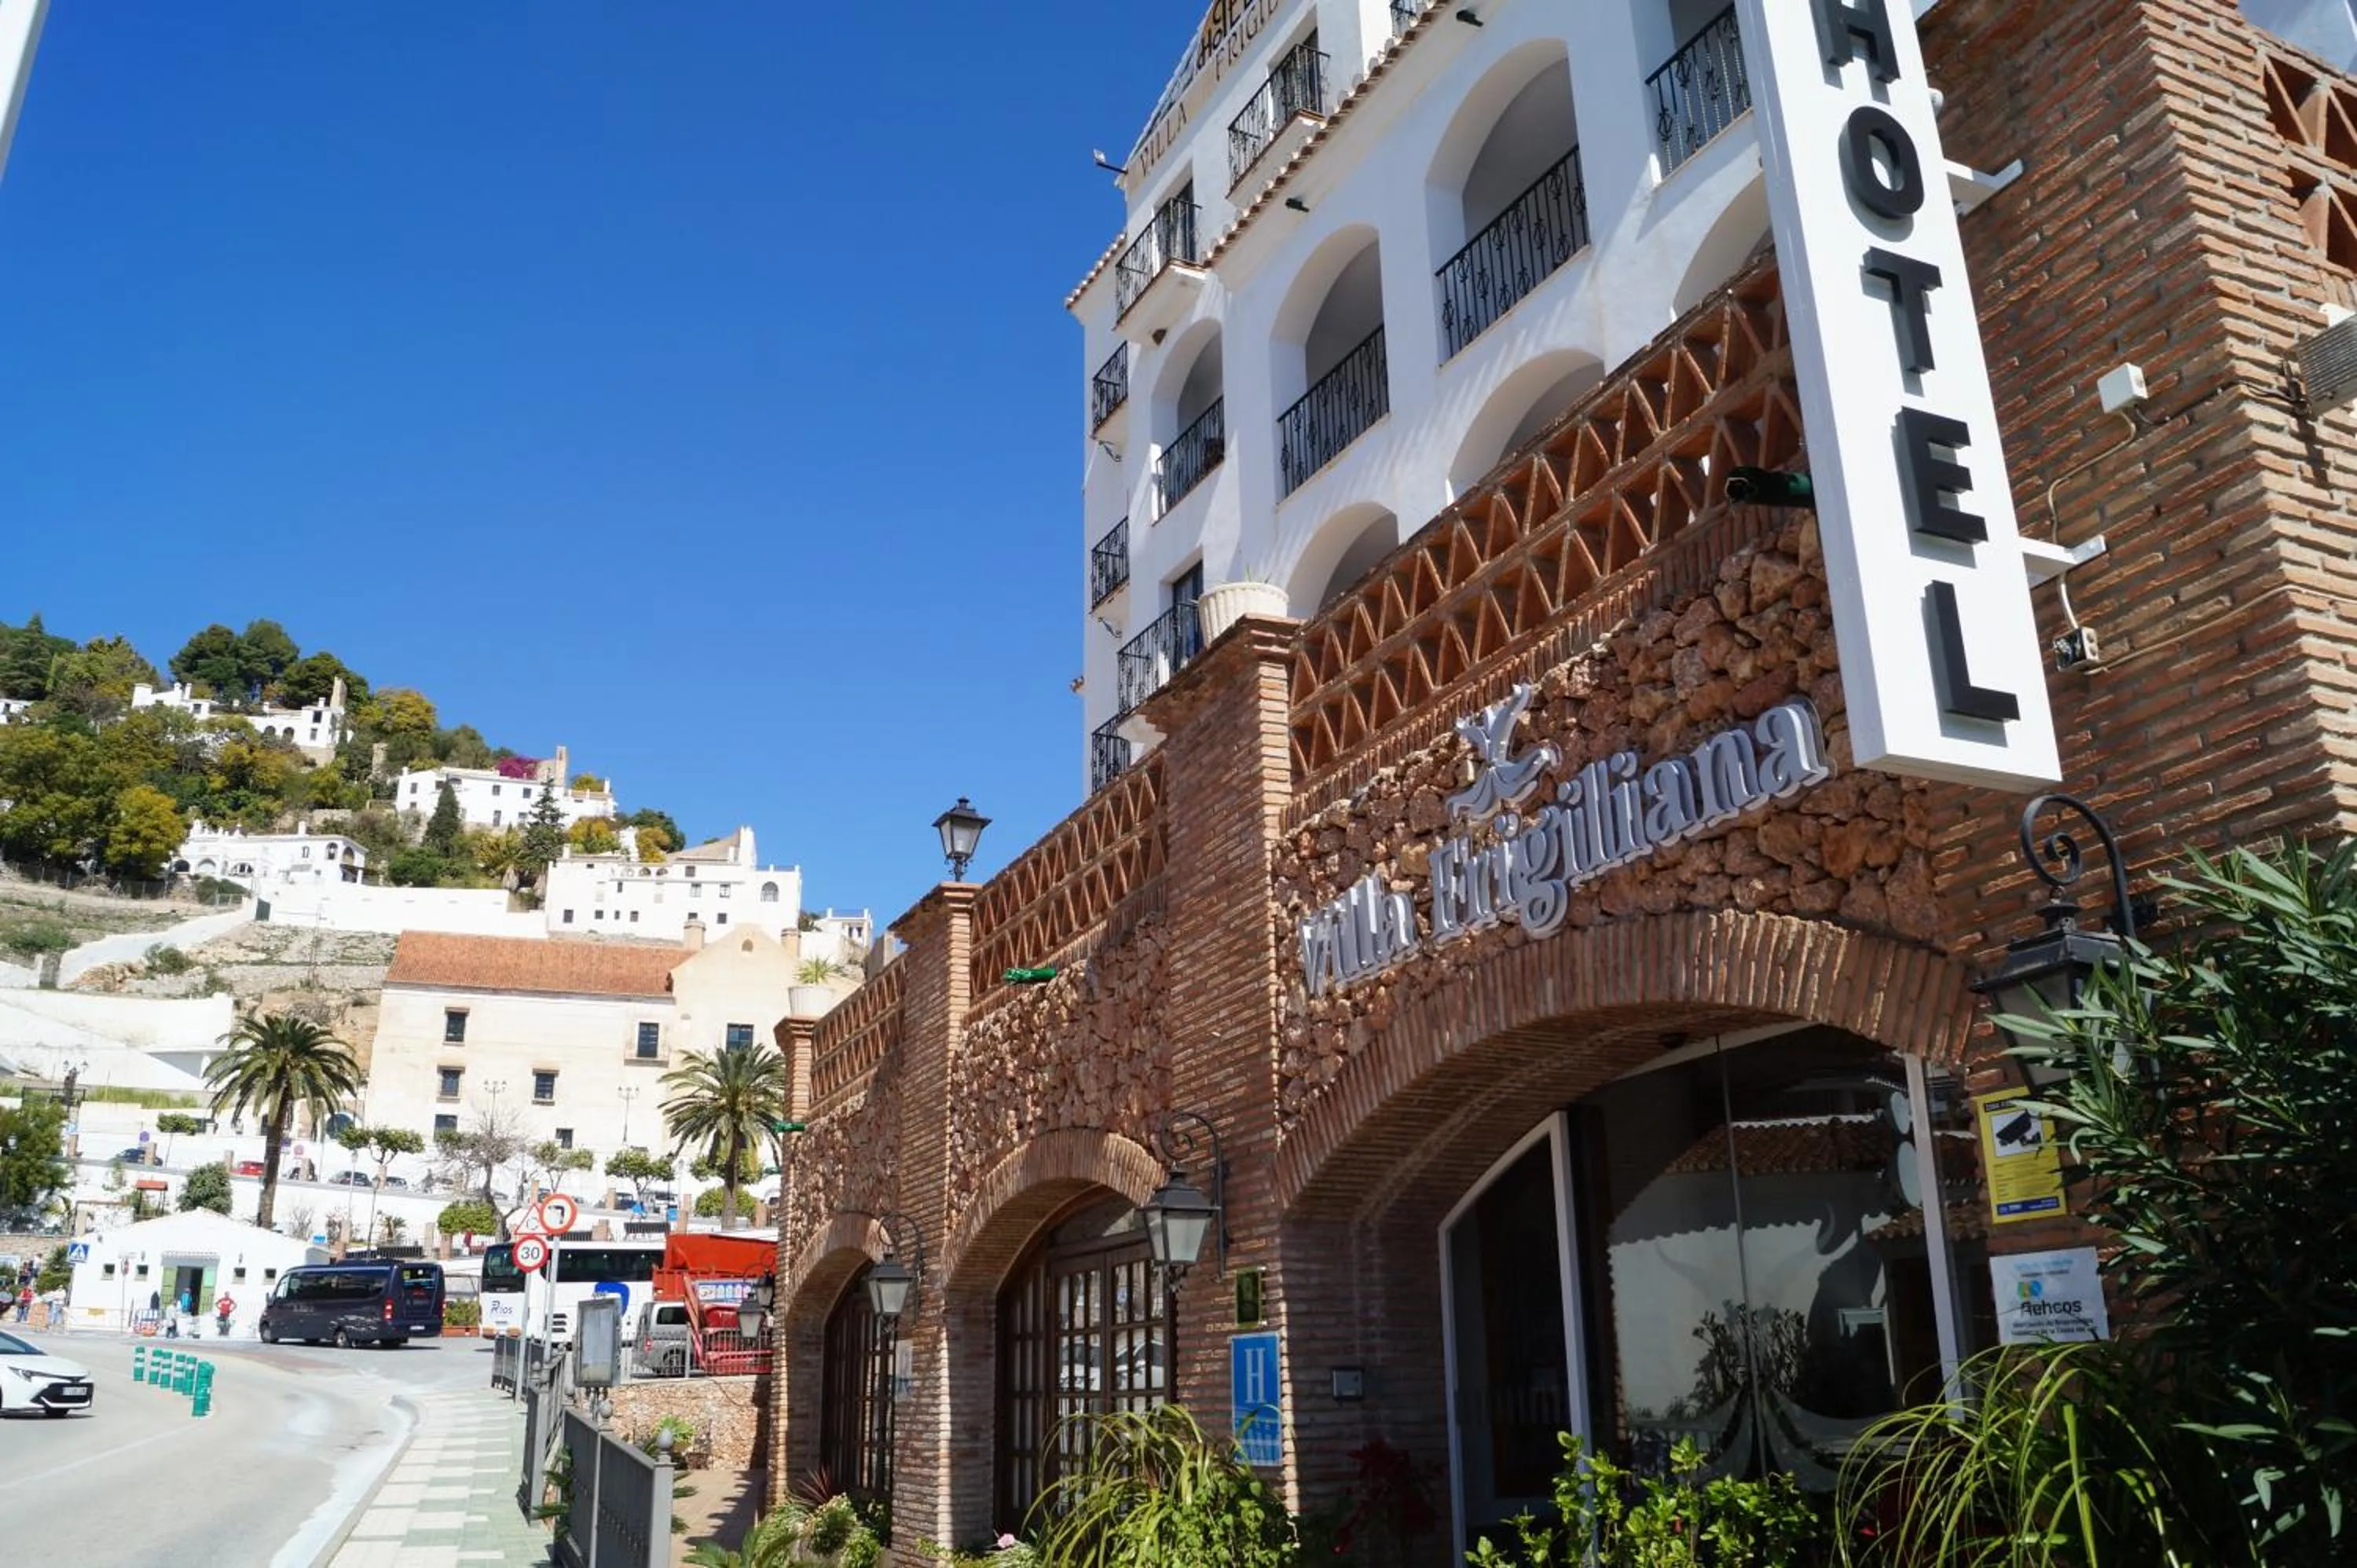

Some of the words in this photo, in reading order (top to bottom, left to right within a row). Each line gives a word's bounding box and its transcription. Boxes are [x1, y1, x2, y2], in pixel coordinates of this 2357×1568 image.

[1141, 102, 1187, 177] VILLA
[1816, 0, 2020, 723] HOTEL
[1428, 698, 1830, 943] Frigiliana
[521, 1247, 540, 1259] 30
[1244, 1347, 1266, 1404] H
